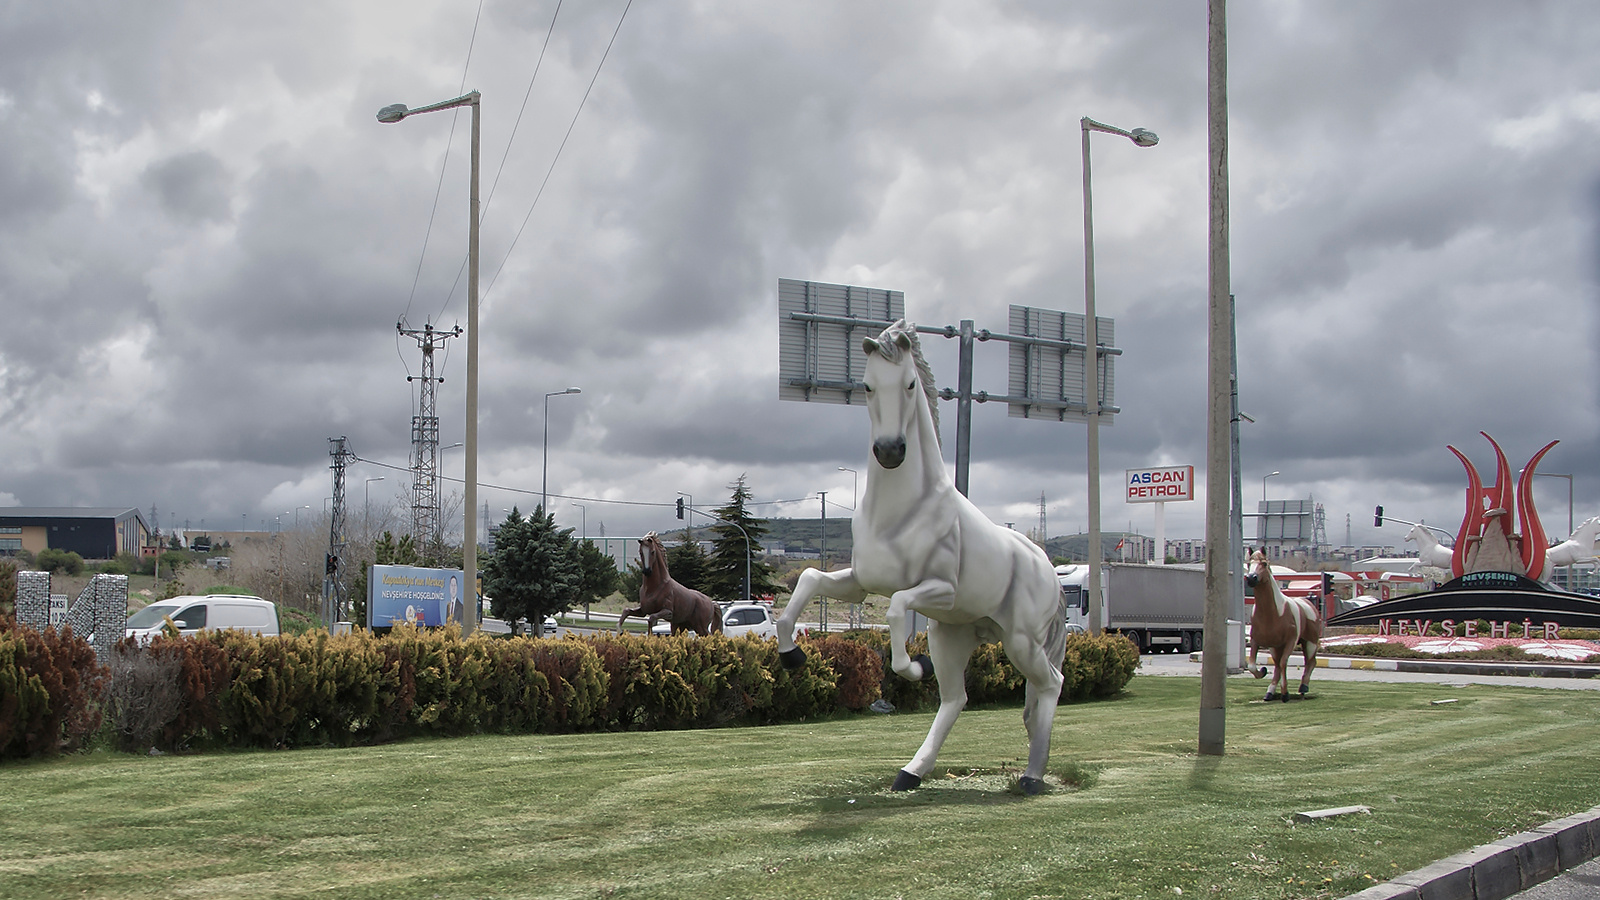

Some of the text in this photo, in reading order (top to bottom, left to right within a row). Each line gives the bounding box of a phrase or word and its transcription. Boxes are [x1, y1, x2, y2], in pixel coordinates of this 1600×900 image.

[1130, 471, 1184, 484] ASCAN
[1128, 484, 1186, 497] PETROL
[1462, 572, 1517, 582] NEVŞEHİR
[51, 600, 66, 609] AKSİ
